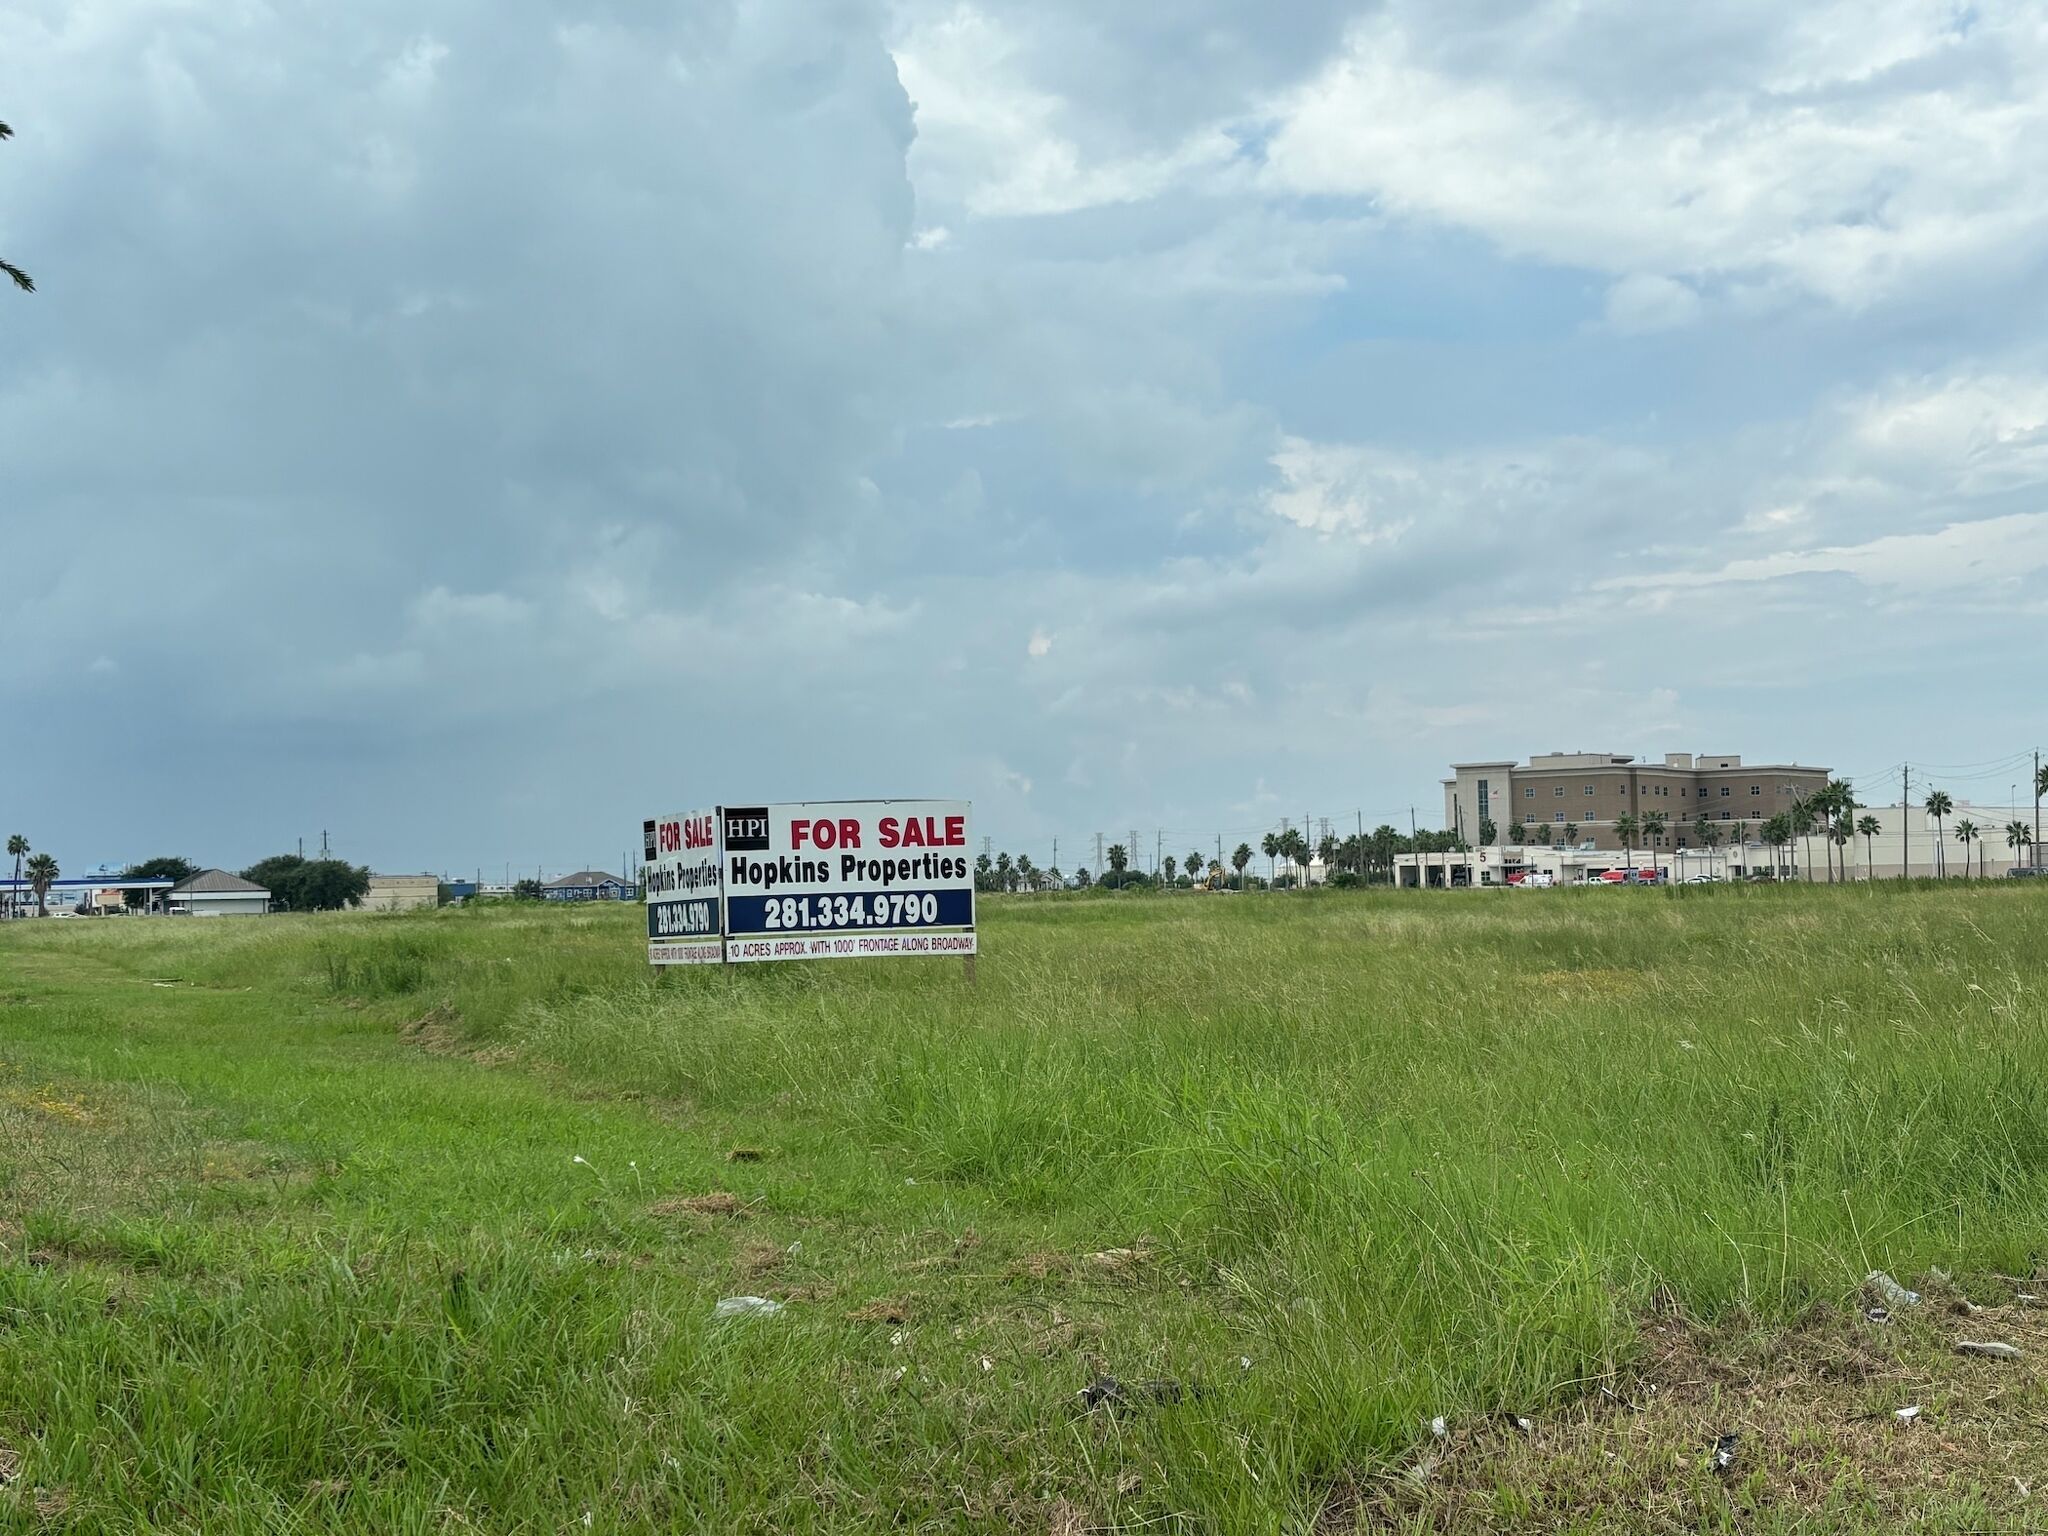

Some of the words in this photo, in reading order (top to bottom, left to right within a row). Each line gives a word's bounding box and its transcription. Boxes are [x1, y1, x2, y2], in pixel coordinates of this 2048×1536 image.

[659, 821, 681, 852] FOR
[685, 815, 713, 849] SALE
[726, 818, 767, 838] HPI
[791, 819, 861, 850] FOR
[878, 816, 965, 848] SALE
[731, 856, 829, 890] Hopkins
[841, 852, 966, 886] Properties
[1480, 852, 1487, 862] 5
[677, 858, 717, 894] Properties
[657, 902, 709, 933] 281.334.9790
[764, 893, 938, 928] 281.334.9790
[743, 943, 771, 956] ACRES
[774, 941, 807, 955] APPROX.
[858, 938, 899, 951] FRONTAGE
[901, 938, 929, 950] ALONG
[931, 937, 973, 950] BROADWAY
